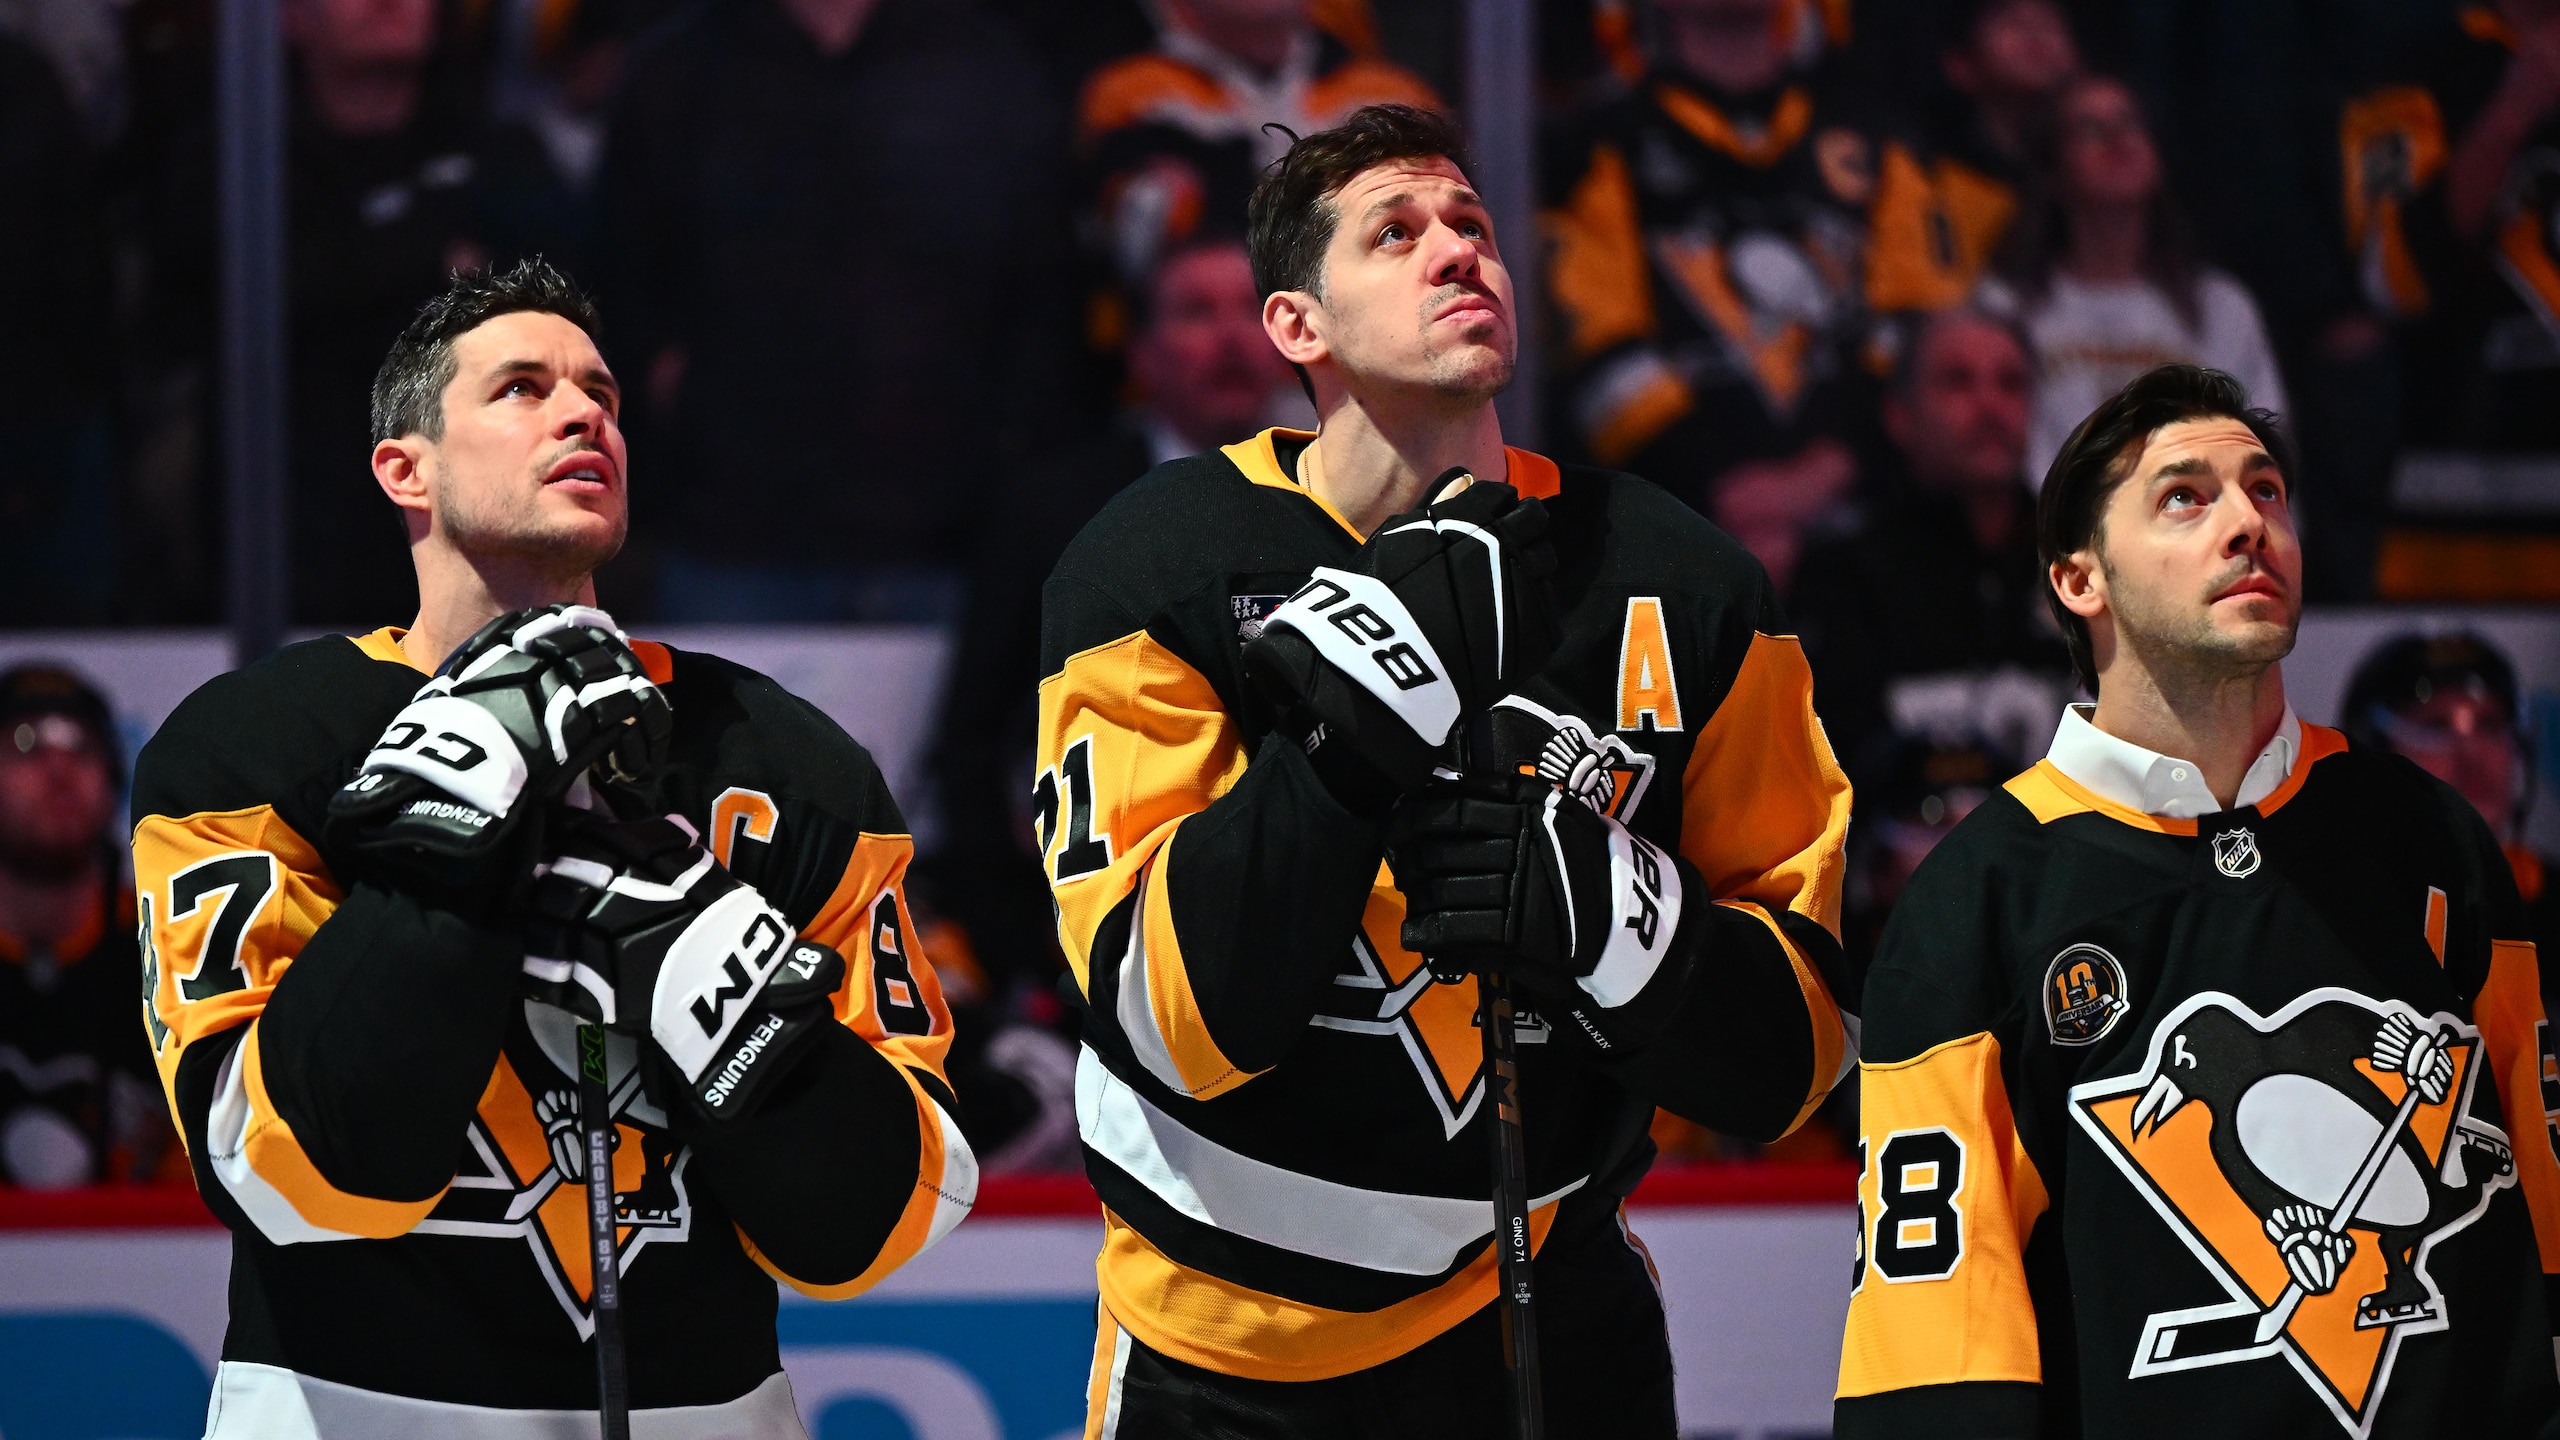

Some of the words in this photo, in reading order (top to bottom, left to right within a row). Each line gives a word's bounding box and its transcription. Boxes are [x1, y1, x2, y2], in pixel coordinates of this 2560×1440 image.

[1616, 596, 1684, 732] A
[710, 786, 780, 882] C
[2226, 841, 2249, 870] NHL
[787, 947, 823, 981] 87
[2055, 961, 2098, 1010] 10
[1571, 1010, 1612, 1049] MALKIN
[704, 1012, 785, 1108] PENGUINS
[590, 1131, 608, 1233] CROSBY
[1512, 1216, 1524, 1248] GINO
[597, 1239, 611, 1273] 87
[1515, 1249, 1525, 1263] 71
